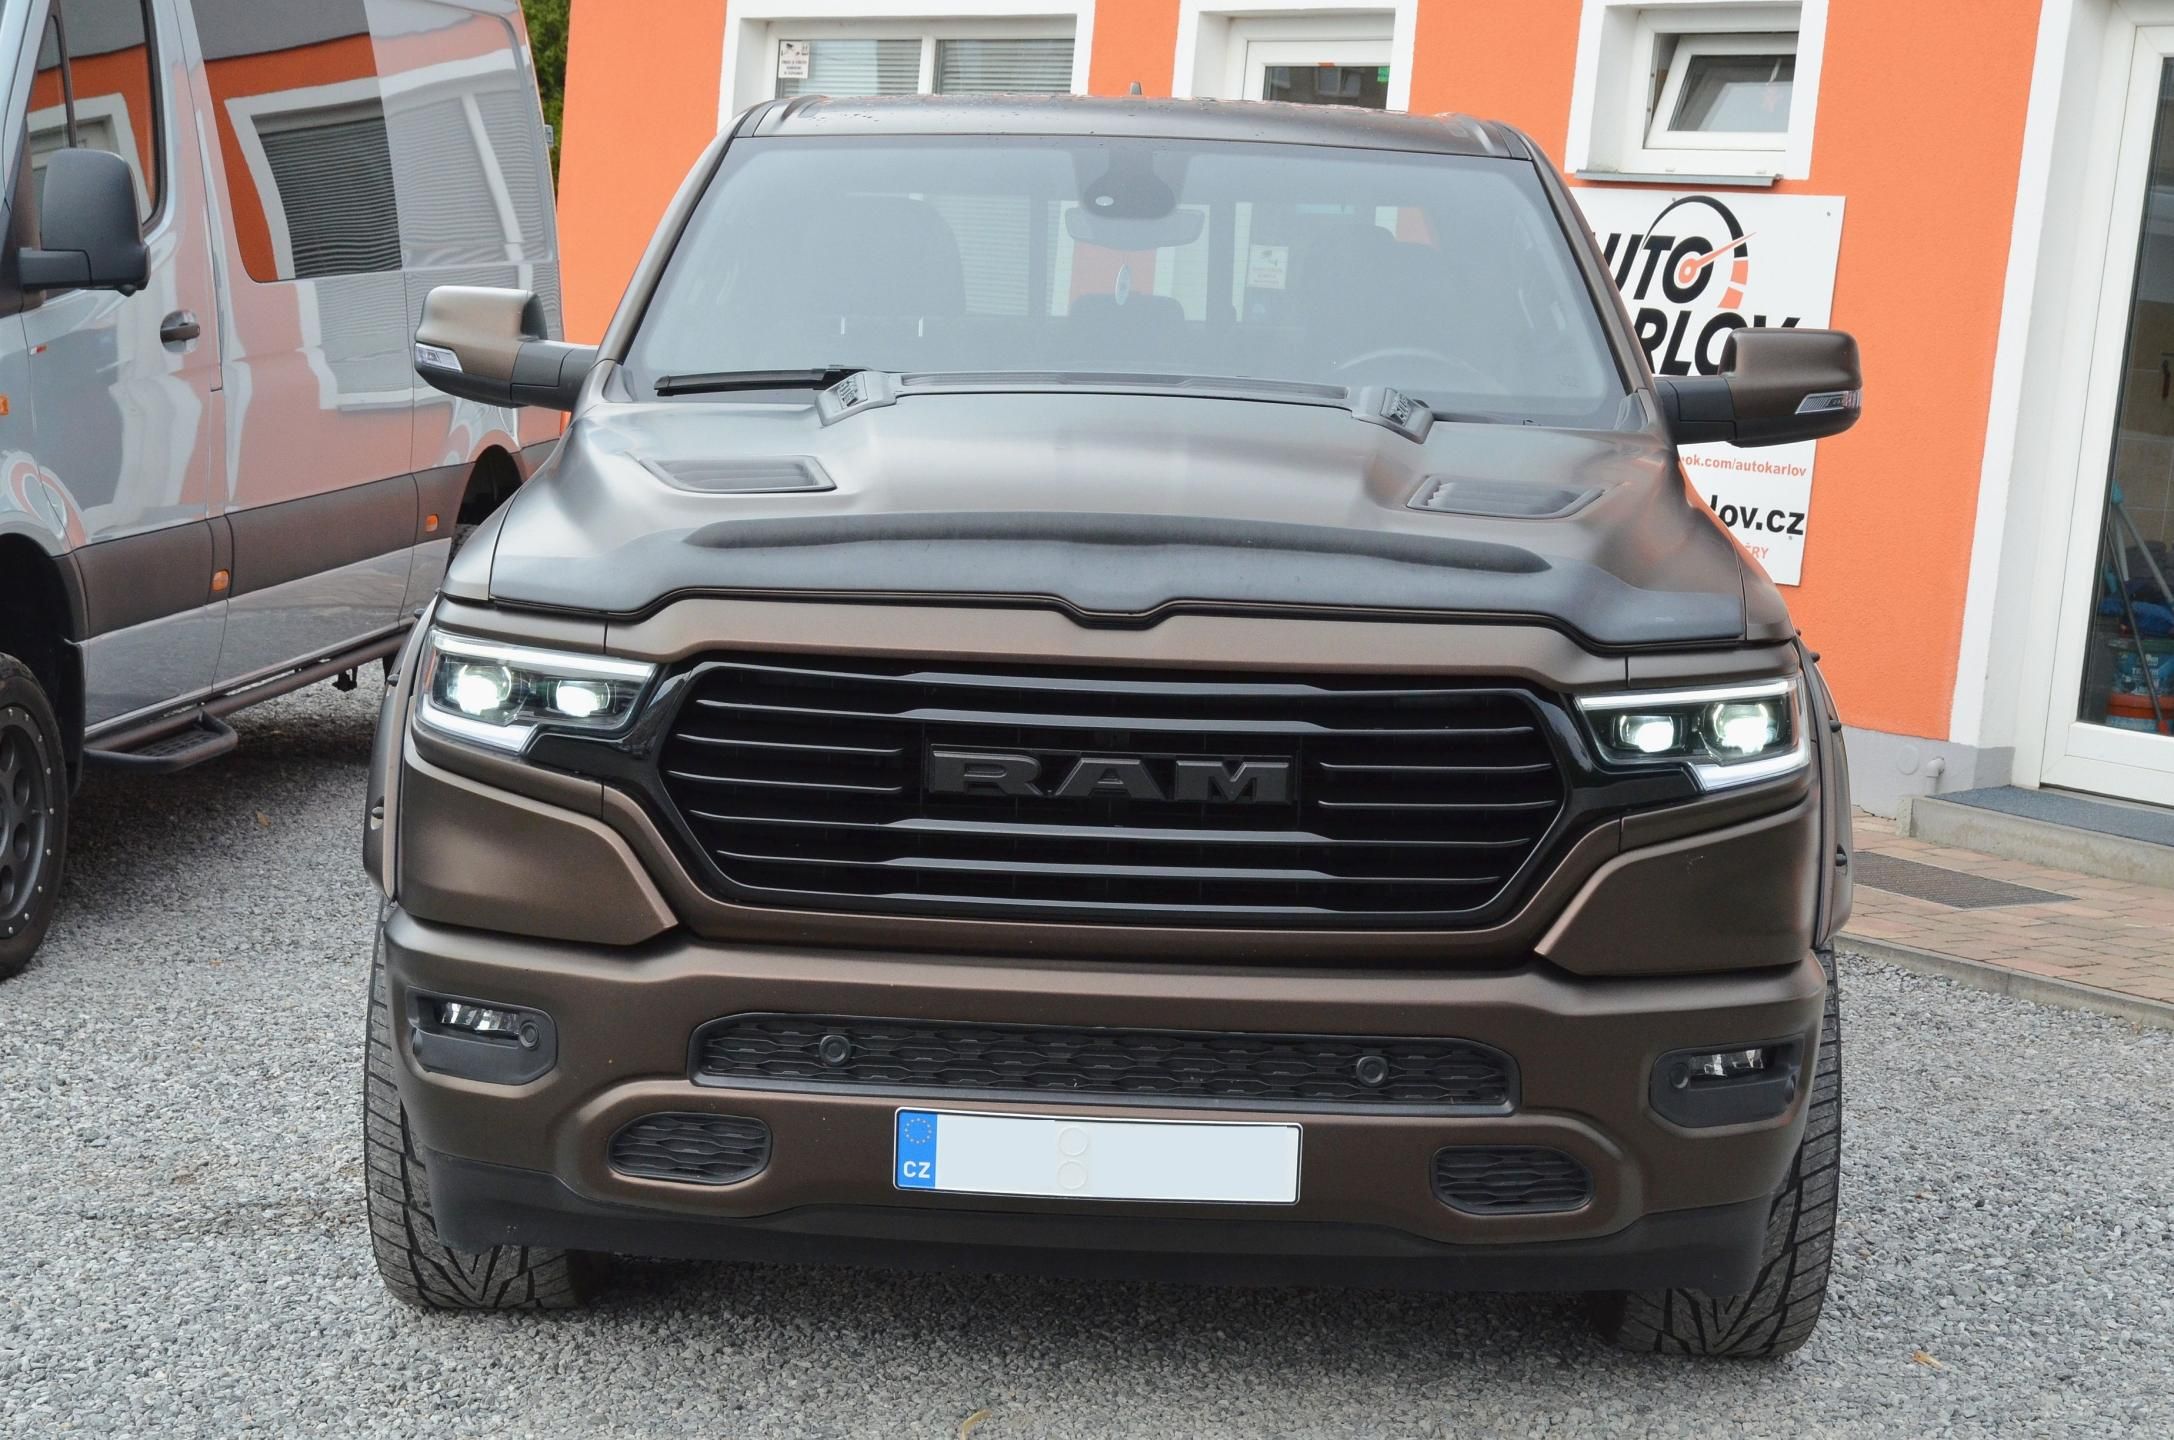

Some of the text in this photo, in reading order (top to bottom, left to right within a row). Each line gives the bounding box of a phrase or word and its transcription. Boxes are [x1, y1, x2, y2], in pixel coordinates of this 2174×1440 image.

[1594, 232, 1714, 304] UTO
[1634, 308, 1801, 376] RLO
[1682, 454, 1807, 476] ok.com/autokarlov
[931, 750, 1291, 803] RAM
[903, 1161, 931, 1179] CZ
